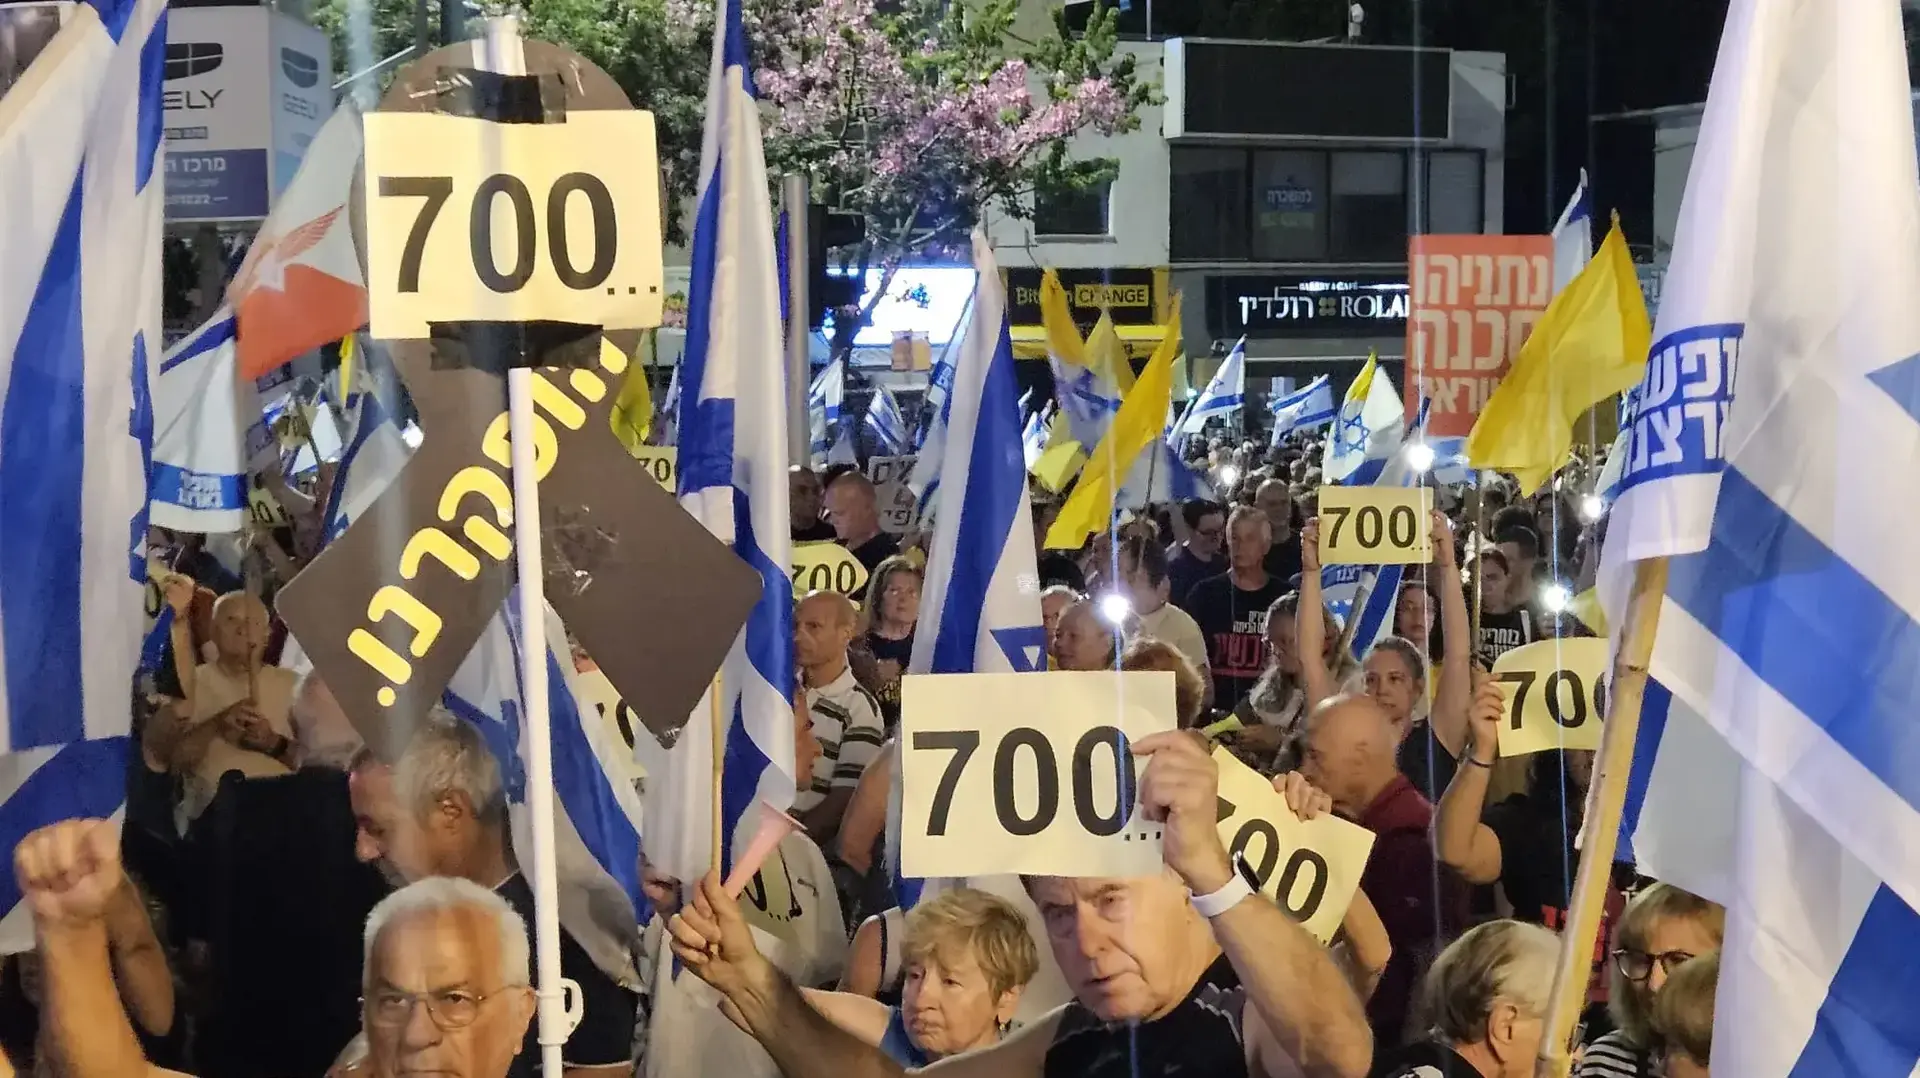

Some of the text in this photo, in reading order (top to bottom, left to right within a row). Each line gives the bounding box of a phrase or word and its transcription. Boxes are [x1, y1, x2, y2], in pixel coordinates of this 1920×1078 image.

[163, 89, 224, 110] ELY
[182, 157, 227, 172] מרכז
[378, 172, 658, 295] 700...
[1413, 254, 1549, 305] נתניהו
[1239, 286, 1314, 325] רולדין
[1341, 294, 1410, 318] ROLA
[1323, 505, 1431, 550] 700...
[912, 725, 1162, 840] 700...
